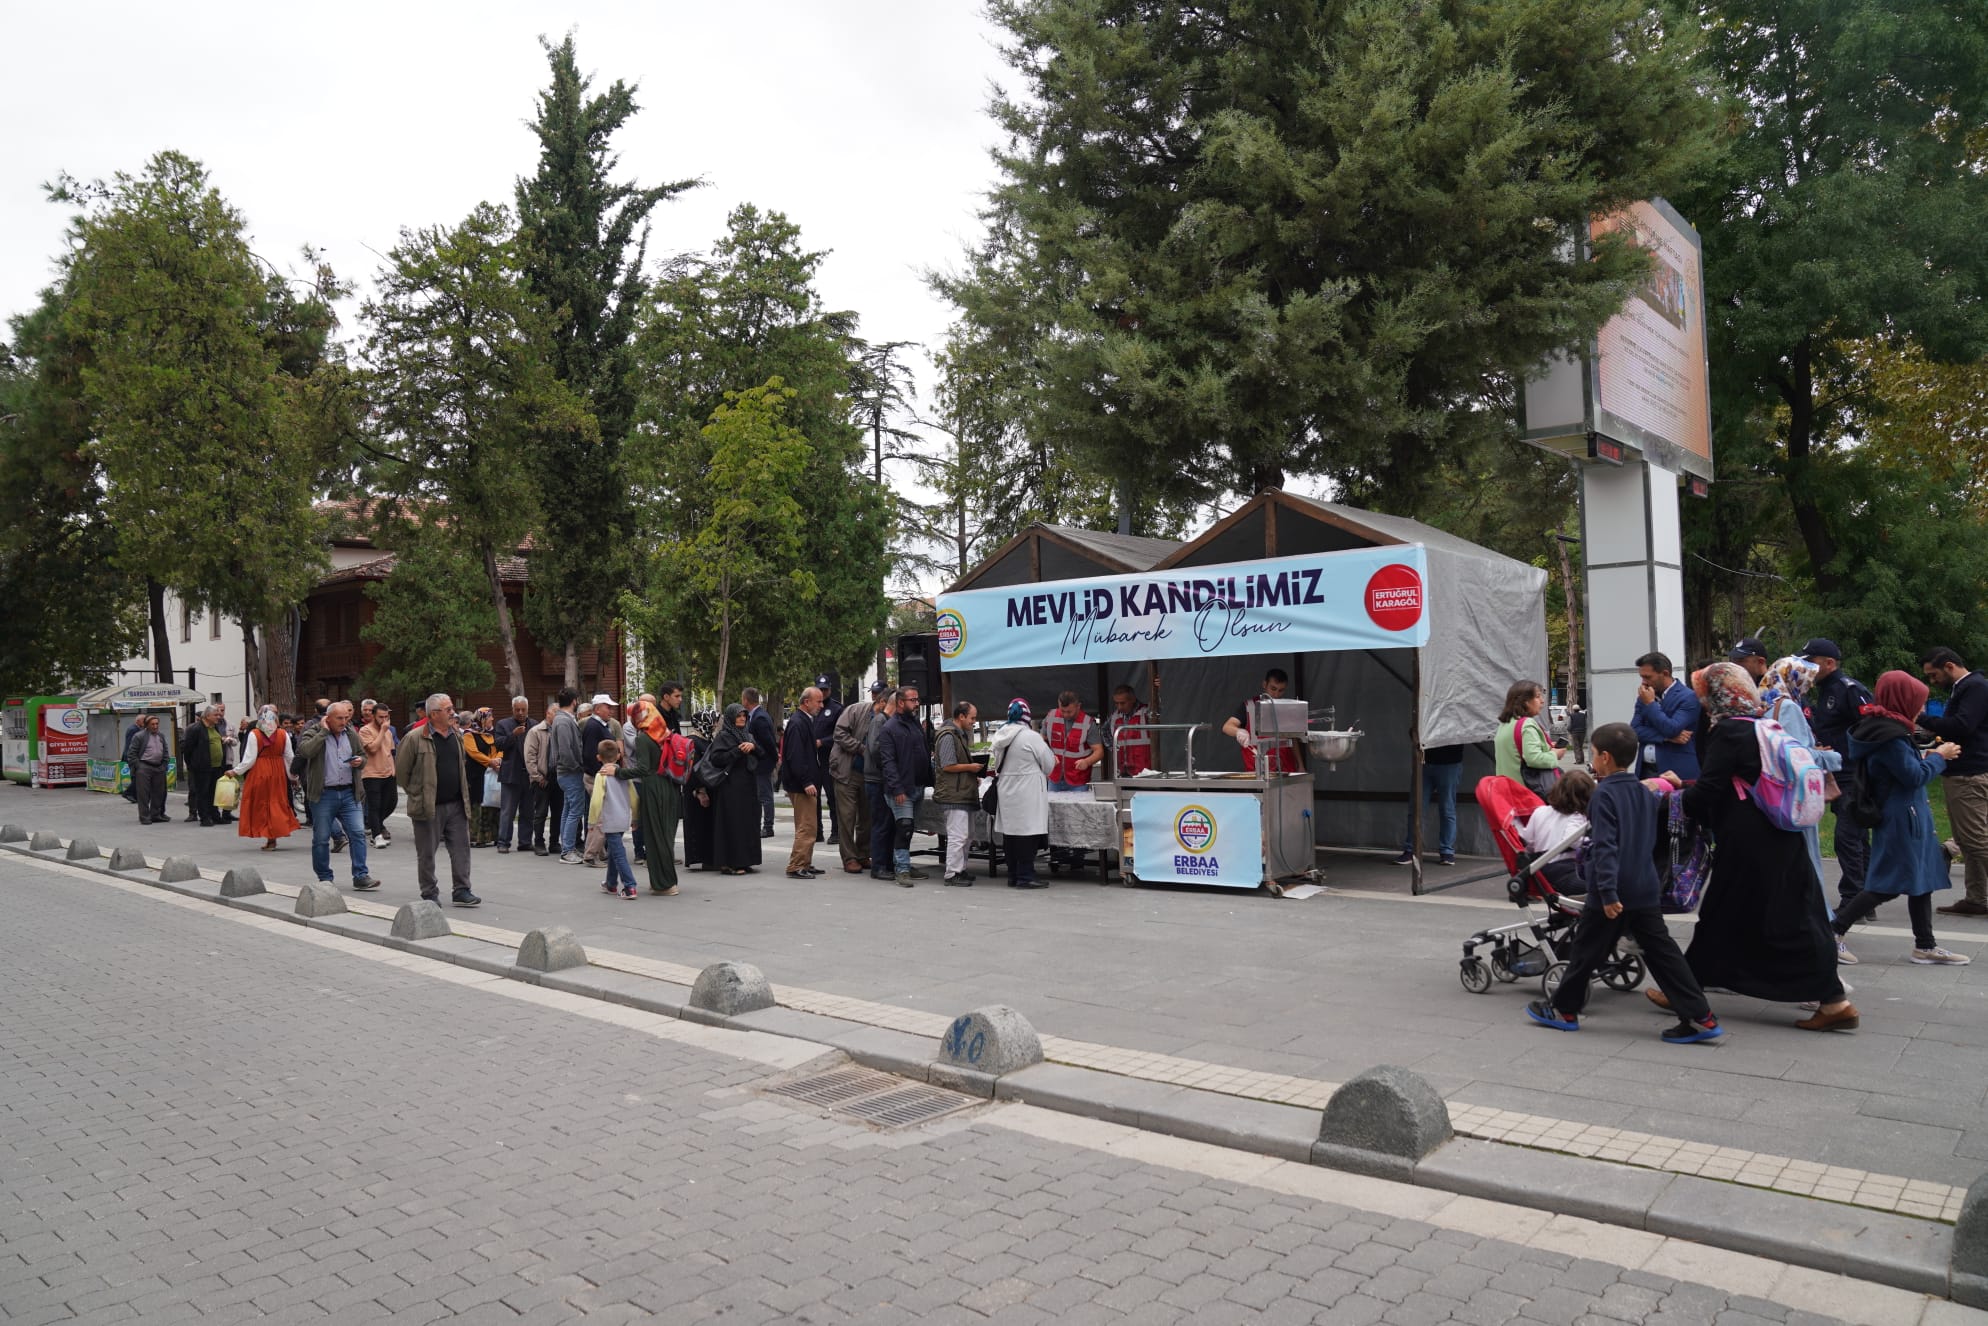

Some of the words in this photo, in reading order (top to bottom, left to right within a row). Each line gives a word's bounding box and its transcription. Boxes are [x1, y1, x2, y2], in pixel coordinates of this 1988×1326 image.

[1375, 588, 1418, 599] ERTUĞRUL
[1375, 598, 1418, 608] KARAGÖL
[1061, 606, 1173, 659] Mübarek
[1194, 598, 1291, 652] Olsun
[1174, 855, 1219, 868] ERBAA
